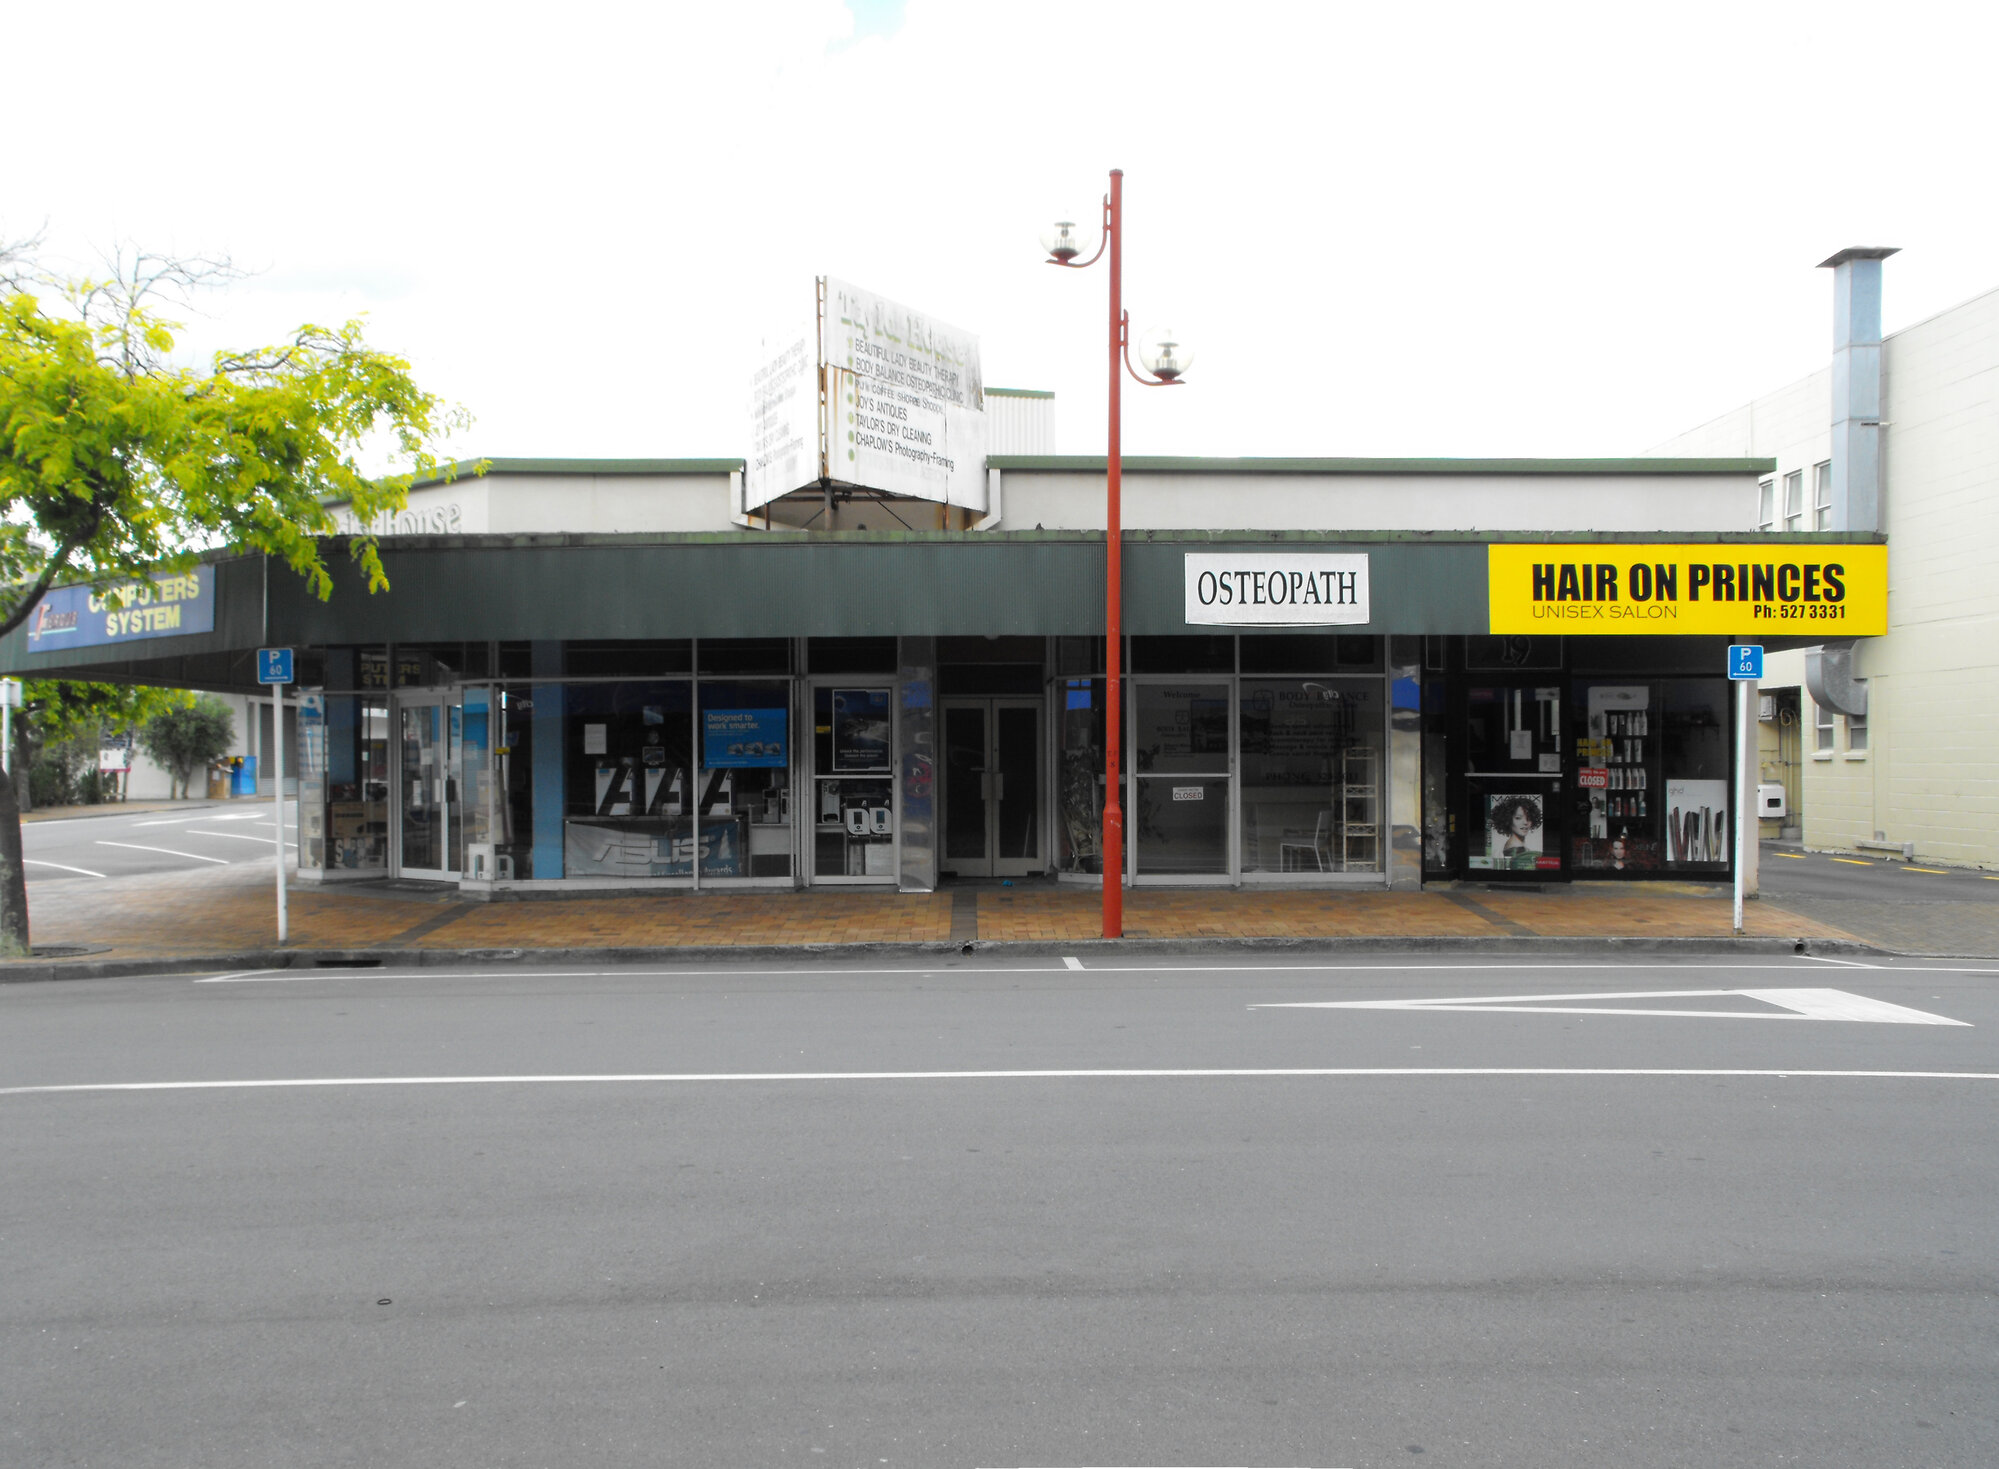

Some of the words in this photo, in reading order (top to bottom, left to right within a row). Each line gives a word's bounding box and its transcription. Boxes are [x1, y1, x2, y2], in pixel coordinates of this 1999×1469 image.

[856, 356, 874, 374] BODY
[876, 401, 908, 422] ANTIQUES
[886, 421, 900, 437] DRY
[902, 426, 932, 446] CLEANING
[1198, 570, 1358, 605] OSTEOPATH
[1532, 563, 1618, 601] HAIR
[1629, 562, 1678, 602] ON
[1688, 562, 1846, 602] PRINCES
[1532, 605, 1604, 619] UNISEX
[1609, 605, 1678, 619] SALON
[1754, 605, 1777, 618] Ph:
[1781, 605, 1805, 618] 527
[1809, 605, 1846, 618] 3331
[106, 604, 181, 637] SYSTEM
[269, 651, 280, 663] P
[1741, 648, 1751, 660] P
[270, 664, 282, 675] 60
[1740, 661, 1752, 671] 60
[707, 713, 743, 723] Designed
[744, 714, 753, 722] to
[707, 722, 727, 730] work
[1580, 776, 1605, 786] CLOSED
[1174, 792, 1203, 800] CLOSED
